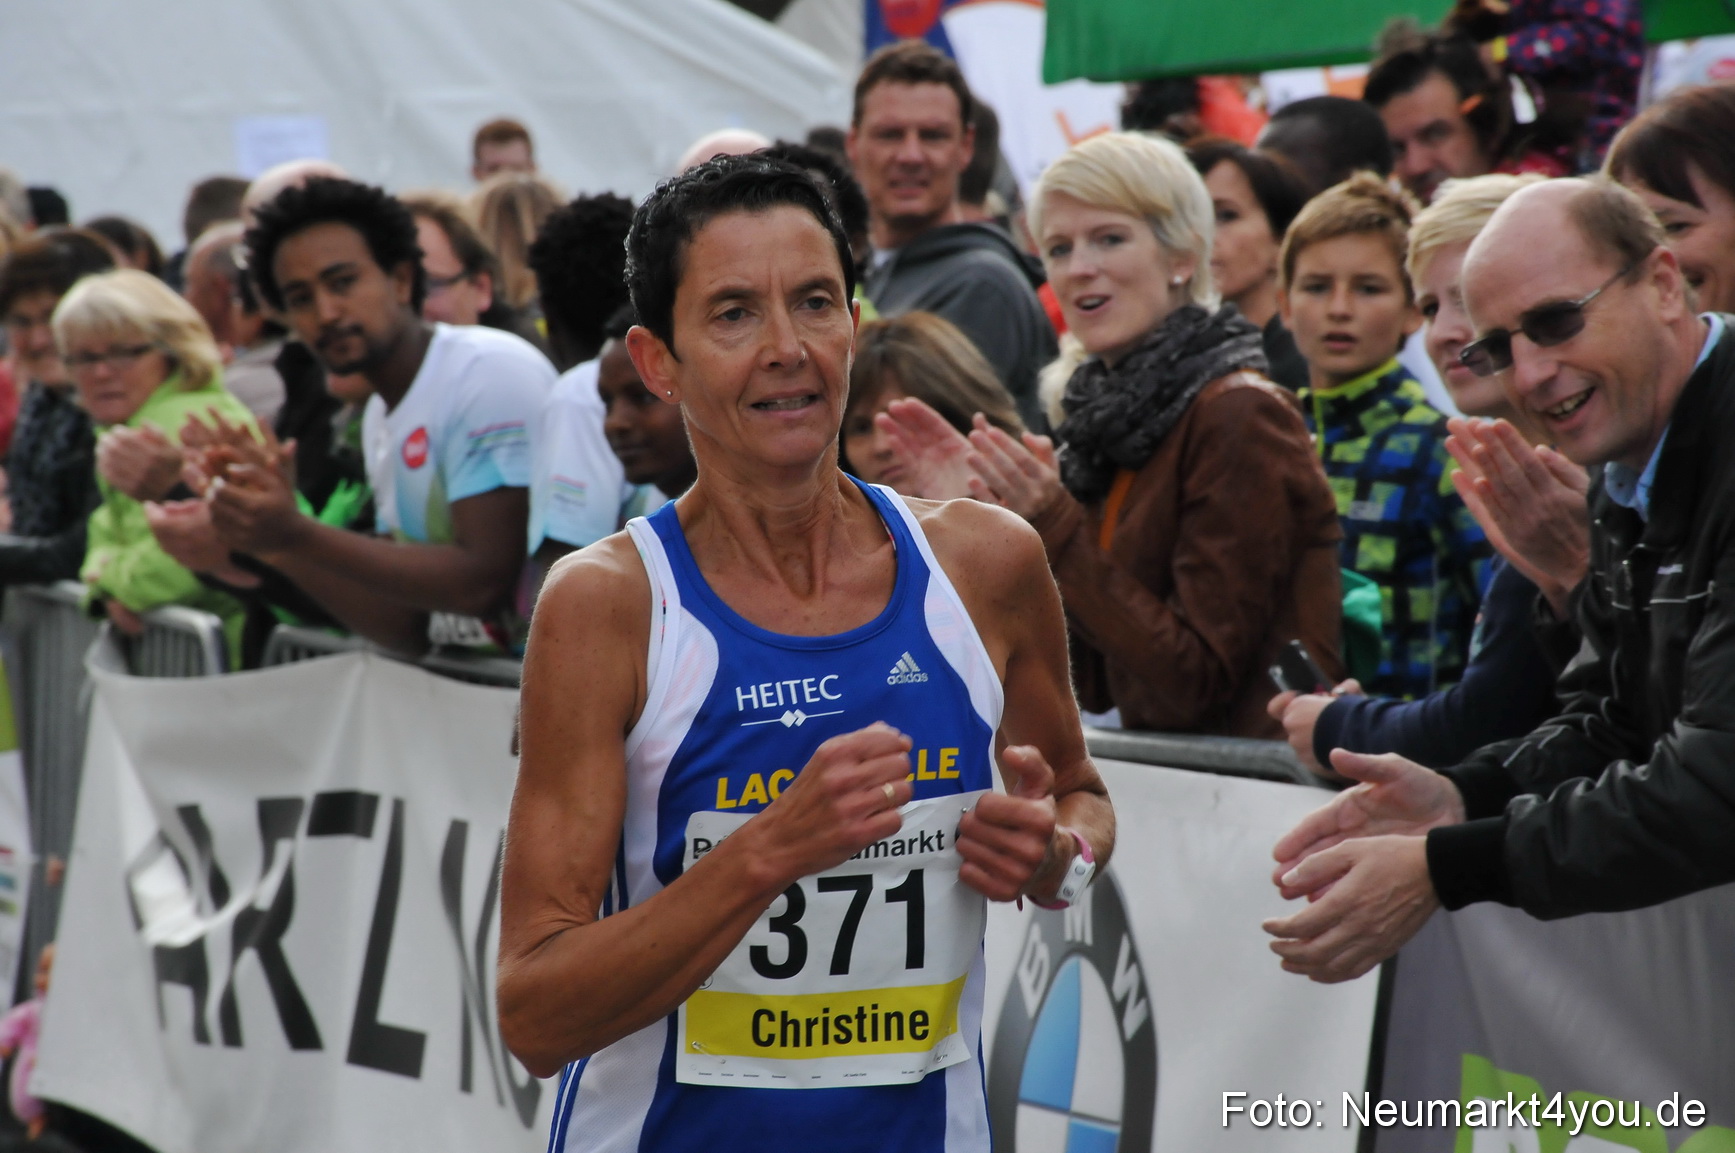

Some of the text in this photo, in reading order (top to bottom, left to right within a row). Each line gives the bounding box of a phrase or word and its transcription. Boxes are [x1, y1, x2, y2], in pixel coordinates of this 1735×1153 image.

[735, 674, 843, 712] HEITEC
[887, 672, 929, 686] adidas
[849, 829, 946, 861] markt
[749, 868, 925, 980] 371
[751, 1002, 930, 1049] Christine
